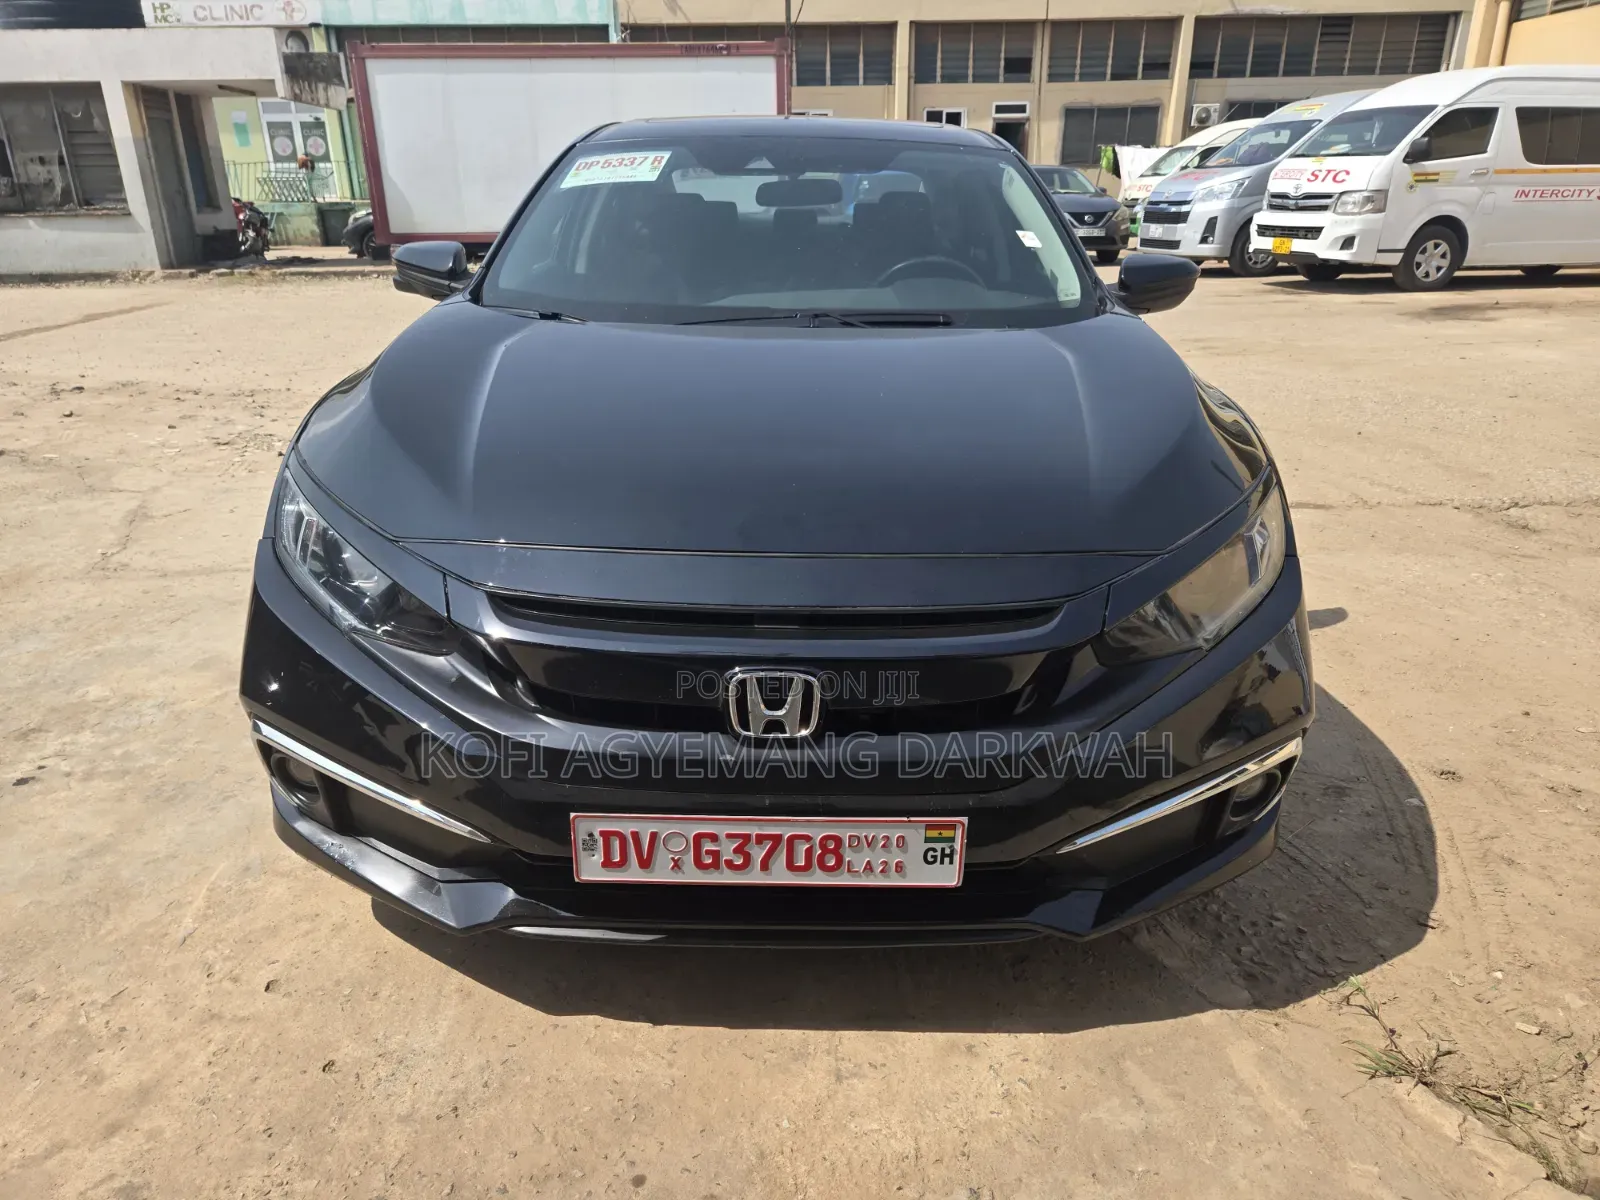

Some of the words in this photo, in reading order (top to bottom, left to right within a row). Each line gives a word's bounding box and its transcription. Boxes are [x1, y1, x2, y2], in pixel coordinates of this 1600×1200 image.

[193, 4, 264, 22] CLINIC
[303, 128, 325, 136] CLINIC
[574, 161, 601, 172] DP
[600, 156, 650, 169] 5337
[650, 155, 665, 166] R
[1306, 169, 1351, 184] STC
[1137, 184, 1153, 192] STC
[1514, 188, 1596, 199] INTERCITY
[598, 829, 658, 870] DV
[692, 831, 844, 873] G3708
[923, 847, 954, 866] GH
